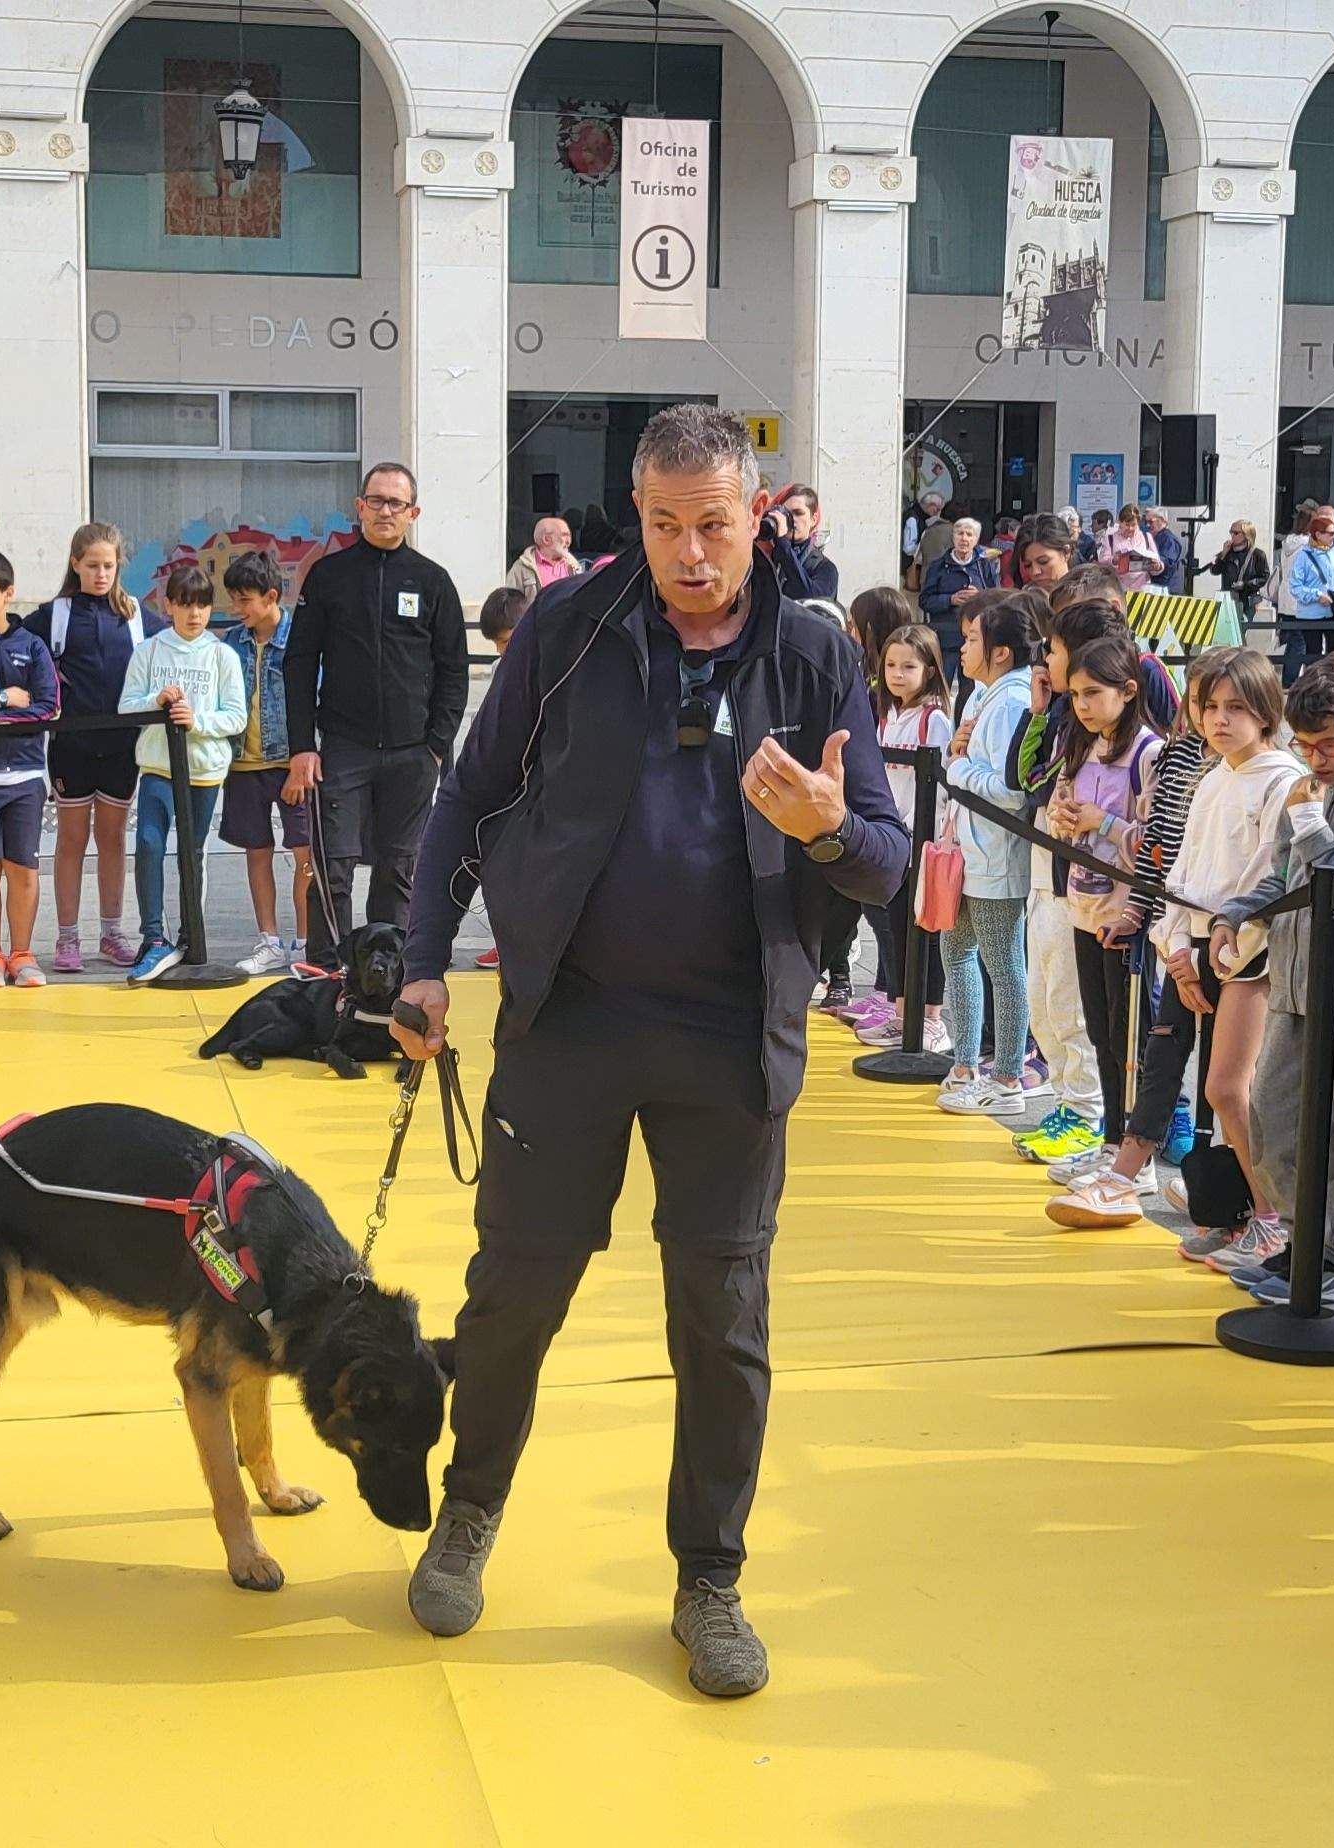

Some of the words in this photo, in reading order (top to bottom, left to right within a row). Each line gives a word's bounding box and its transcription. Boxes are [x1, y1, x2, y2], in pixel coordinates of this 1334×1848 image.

[639, 140, 698, 158] Oficina
[676, 161, 698, 177] de
[630, 180, 697, 197] Turismo
[1054, 179, 1102, 204] HUESCA
[1025, 200, 1056, 220] Ciudad
[1057, 202, 1067, 218] de
[935, 438, 969, 482] HUESCA
[152, 665, 211, 683] UNLIMITED
[217, 1260, 239, 1285] ONCE
